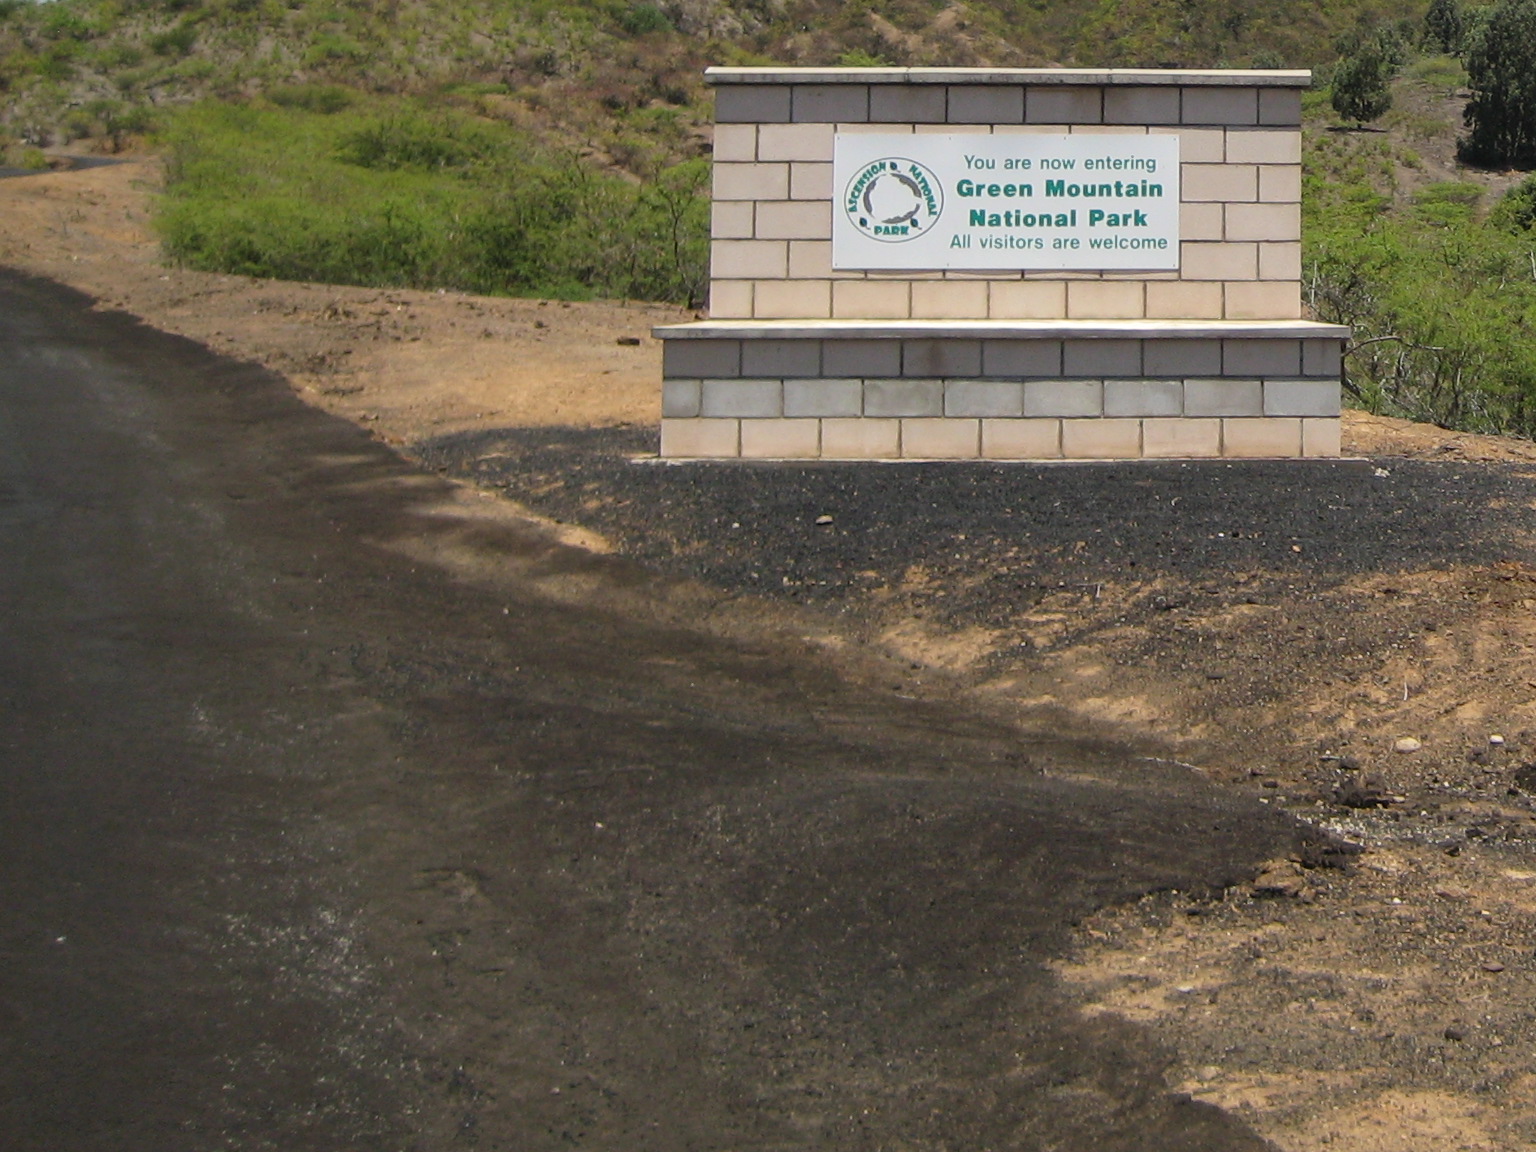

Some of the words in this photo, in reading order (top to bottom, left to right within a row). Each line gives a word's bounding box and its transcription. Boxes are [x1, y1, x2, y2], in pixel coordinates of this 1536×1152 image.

[964, 155, 995, 169] You
[1004, 159, 1031, 169] are
[1041, 159, 1075, 169] now
[1084, 155, 1156, 173] entering
[848, 162, 886, 212] ASCENSION
[908, 164, 938, 217] NATIONAL
[957, 179, 1032, 197] Green
[1046, 179, 1162, 197] Mountain
[970, 209, 1076, 227] National
[1089, 209, 1147, 227] Park
[874, 225, 909, 235] PARK
[950, 234, 970, 248] All
[980, 235, 1043, 249] visitors
[1053, 238, 1080, 249] are
[1089, 235, 1167, 249] welcome
